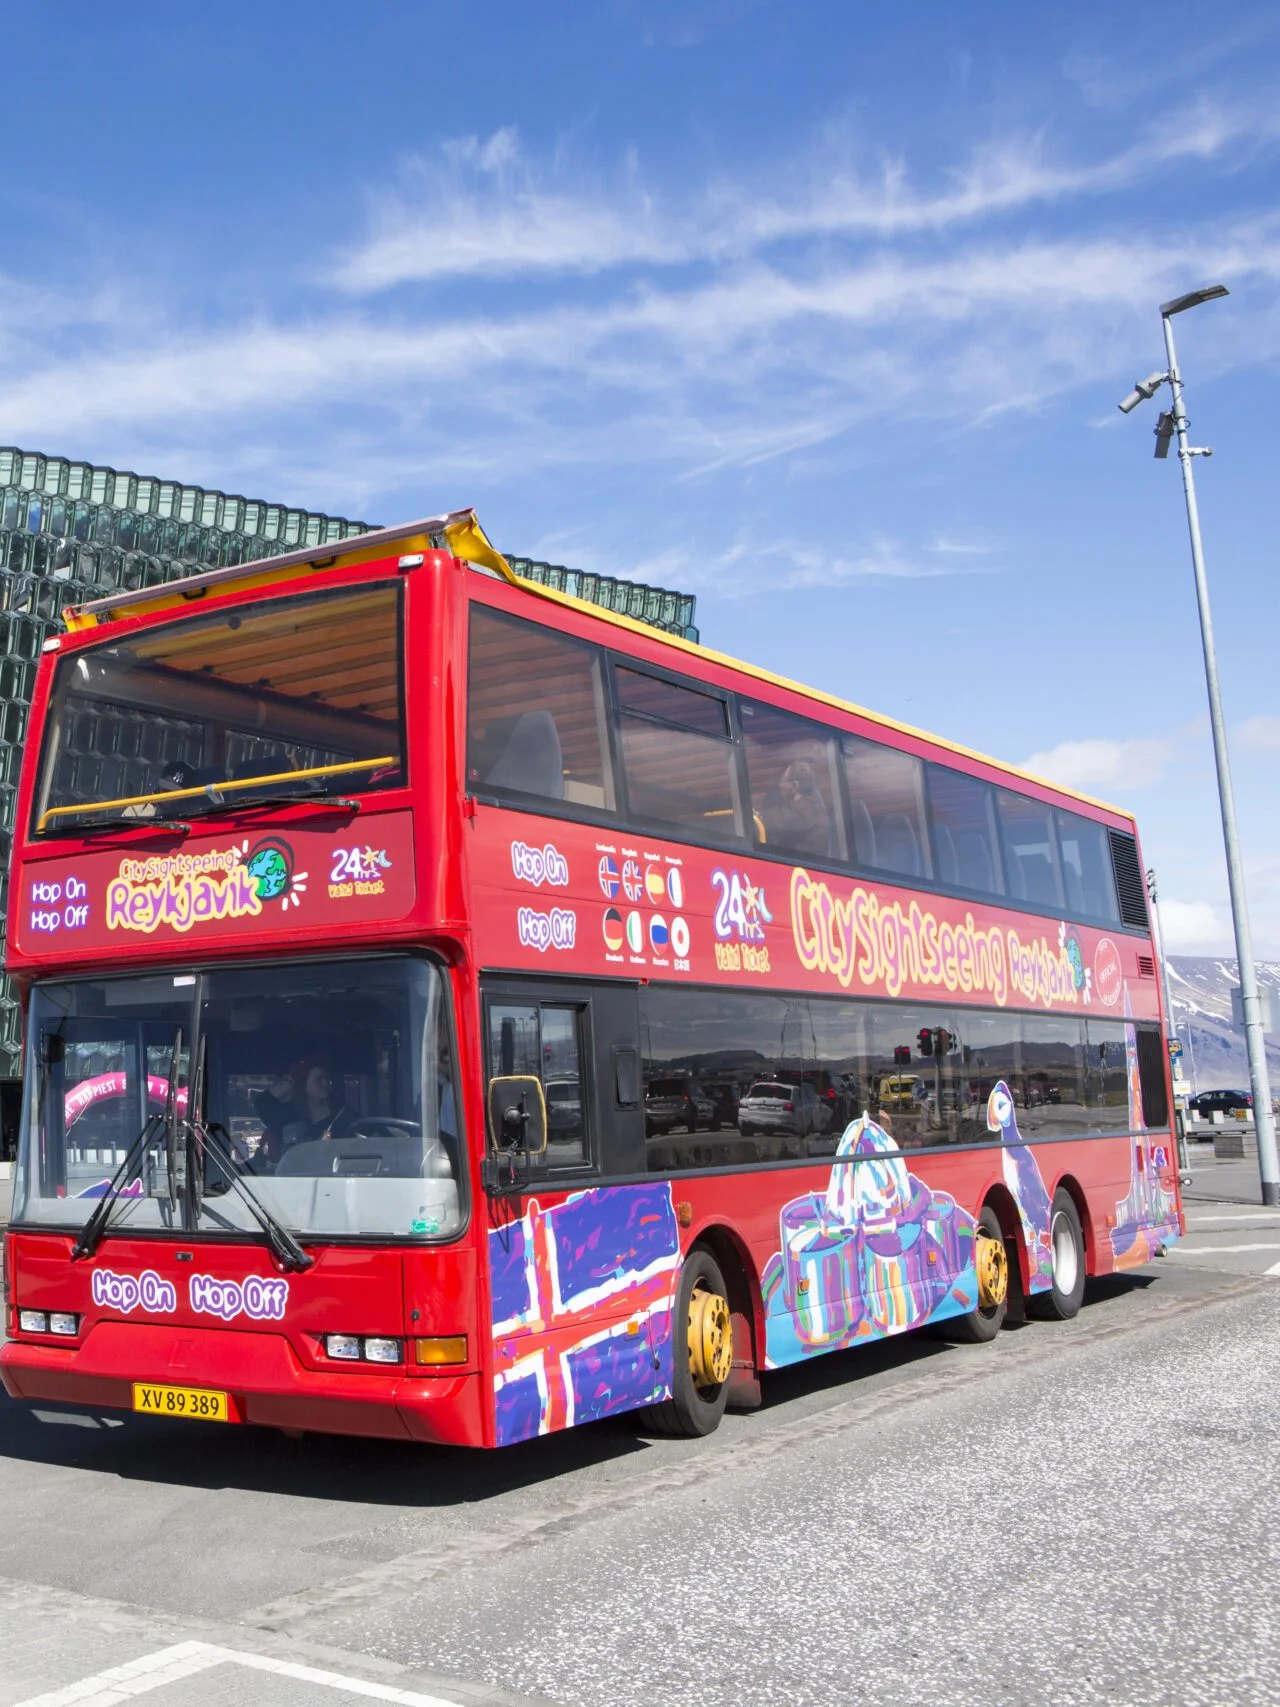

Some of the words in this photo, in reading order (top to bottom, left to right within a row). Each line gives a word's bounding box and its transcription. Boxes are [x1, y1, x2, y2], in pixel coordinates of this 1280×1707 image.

[119, 848, 239, 882] CitySightseeing
[331, 847, 362, 882] 24
[511, 841, 544, 886] Hop
[544, 844, 568, 886] On
[31, 881, 61, 904] Hop
[65, 877, 87, 900] On
[107, 867, 261, 932] Reykjavik
[328, 882, 353, 898] Valid
[354, 880, 385, 896] Ticket
[712, 870, 746, 937] 24
[31, 909, 60, 932] Hop
[65, 904, 89, 929] Off
[518, 907, 550, 952] Hop
[549, 907, 576, 949] Off
[791, 866, 1007, 1007] CitySightseeing
[1007, 930, 1078, 1008] Reykjavik
[715, 942, 740, 971] Valid
[741, 942, 772, 973] Ticket
[77, 1079, 117, 1106] HAPPIEST
[92, 1268, 139, 1314] Hop
[139, 1269, 176, 1313] On
[190, 1274, 242, 1321] Hop
[242, 1275, 289, 1320] Off
[142, 1388, 162, 1409] XV
[166, 1391, 186, 1412] 89
[189, 1394, 220, 1416] 389
